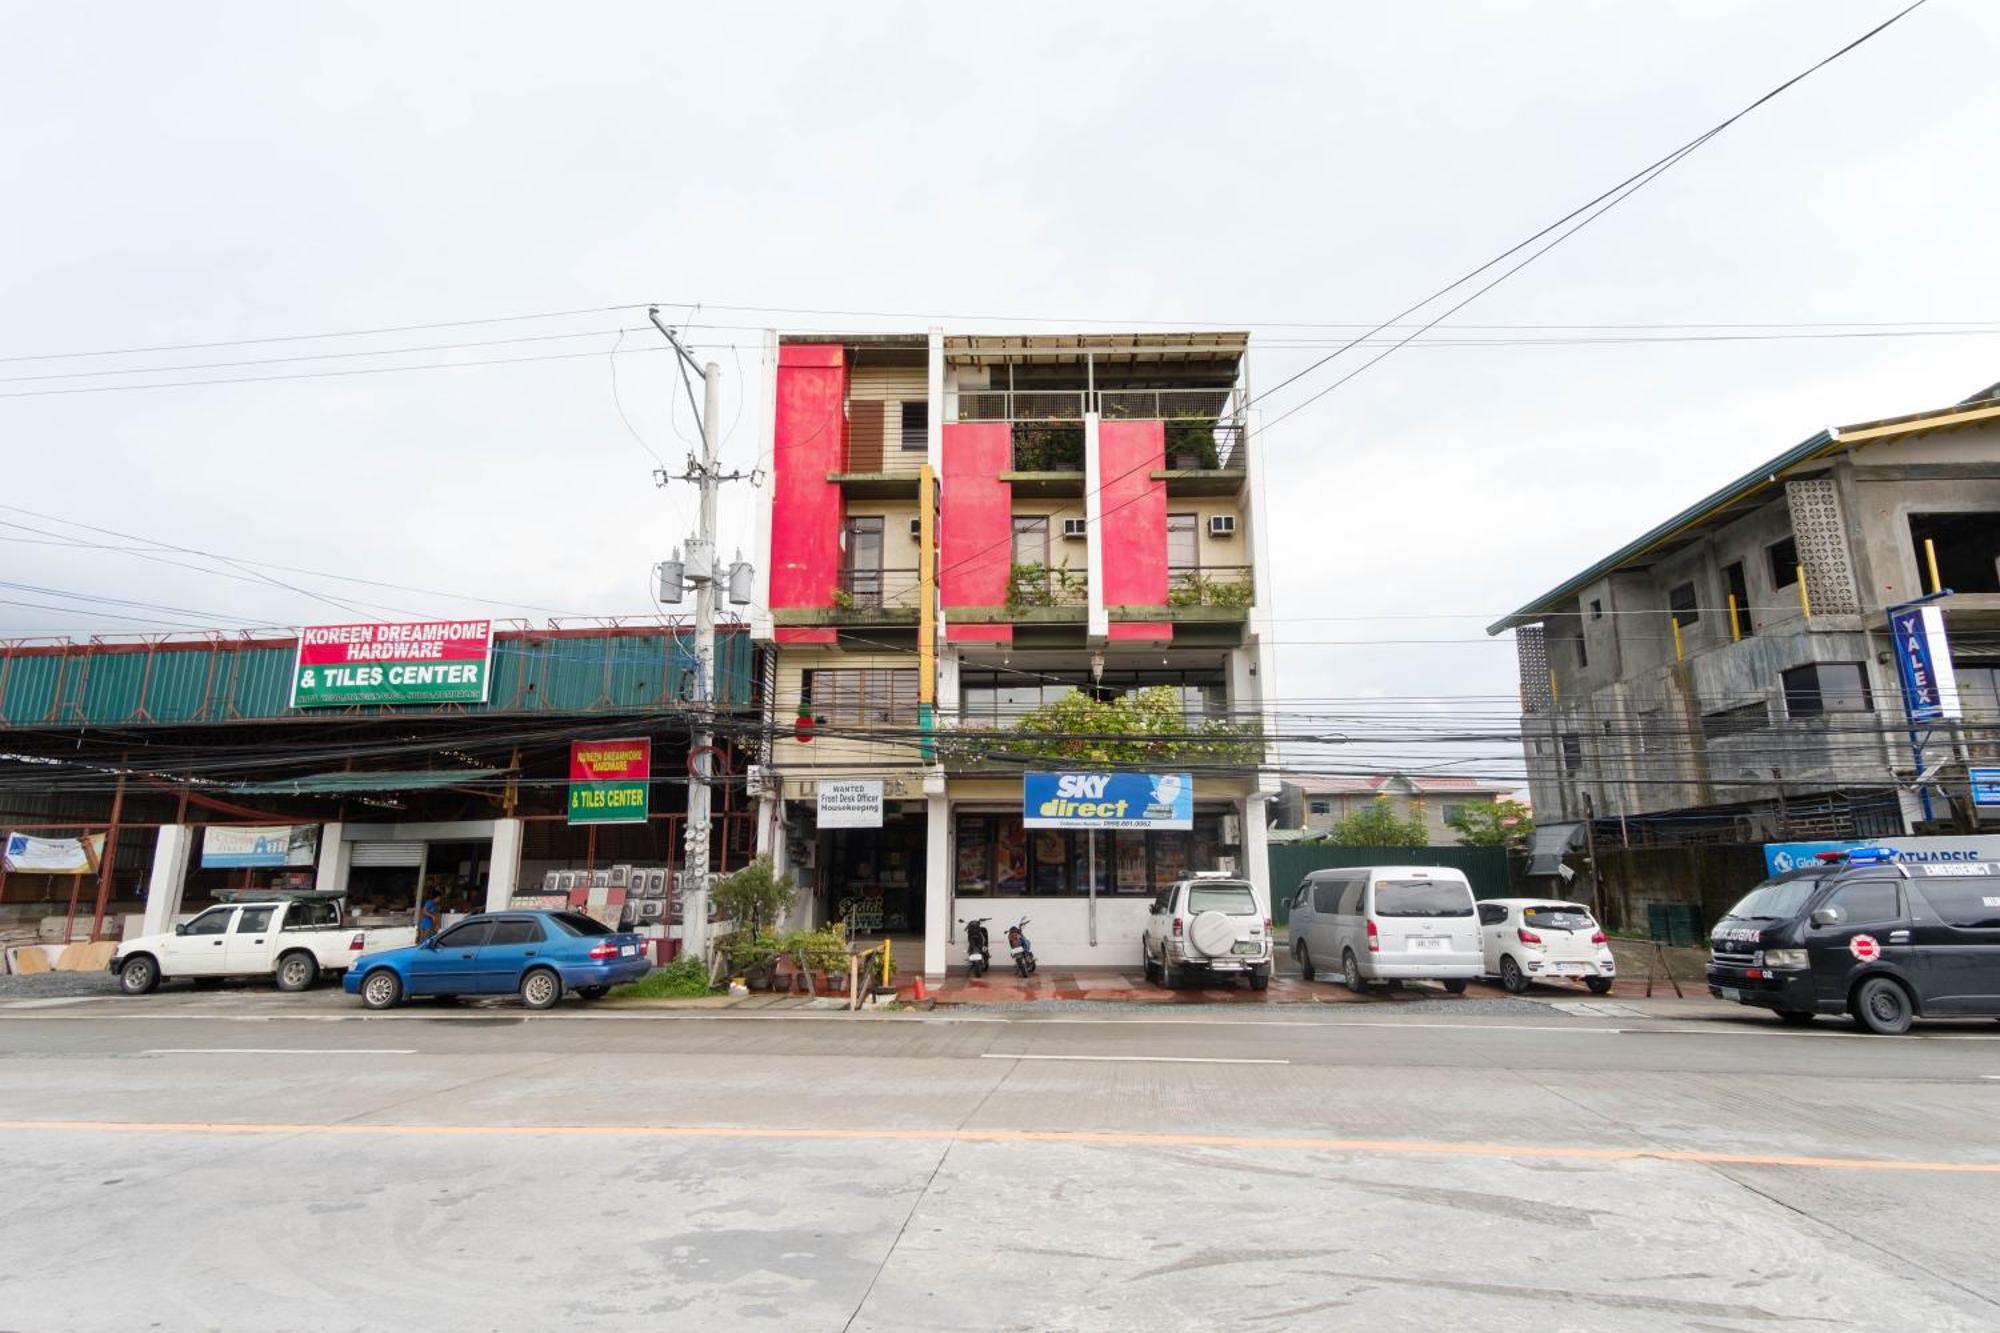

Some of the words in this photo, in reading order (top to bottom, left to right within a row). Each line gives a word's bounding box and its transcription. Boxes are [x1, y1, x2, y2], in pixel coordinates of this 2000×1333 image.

[304, 626, 373, 645] KOREEN
[377, 622, 488, 641] DREAMHOME
[347, 641, 444, 660] HARDWARE
[1902, 617, 1931, 704] YALEX
[300, 669, 316, 688] &
[323, 666, 384, 687] TILES
[389, 664, 478, 685] CENTER
[832, 785, 865, 793] WANTED
[1056, 775, 1112, 798] SKY
[572, 791, 578, 808] &
[581, 790, 605, 807] TILES
[607, 789, 643, 807] CENTER
[820, 793, 838, 803] Front
[839, 793, 856, 803] Desk
[856, 793, 879, 803] Officer
[820, 804, 879, 815] Housekeeping
[1040, 799, 1128, 818] direct
[1923, 863, 1991, 876] EMERGENCY
